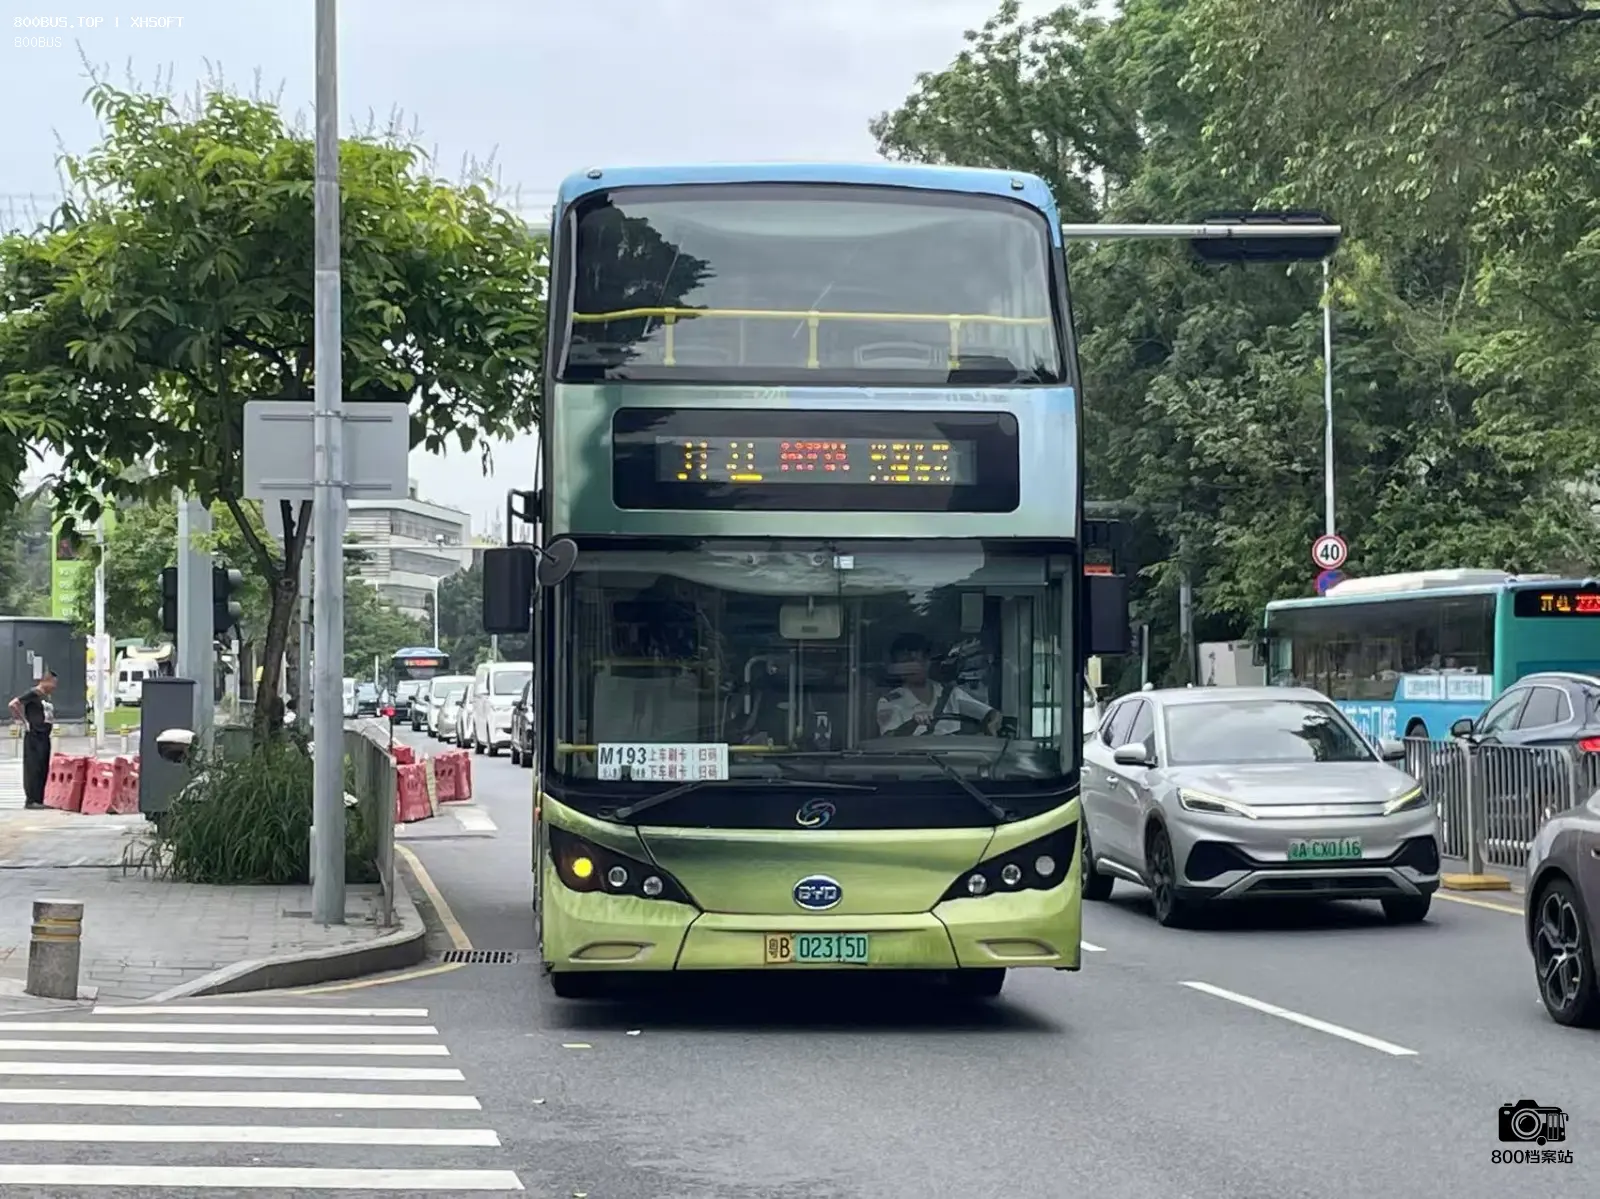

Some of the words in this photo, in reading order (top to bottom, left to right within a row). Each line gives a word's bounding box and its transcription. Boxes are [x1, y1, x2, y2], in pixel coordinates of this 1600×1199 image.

[1320, 543, 1340, 561] 40
[600, 747, 647, 765] M193
[798, 885, 837, 900] BYD
[800, 936, 868, 959] 02315D
